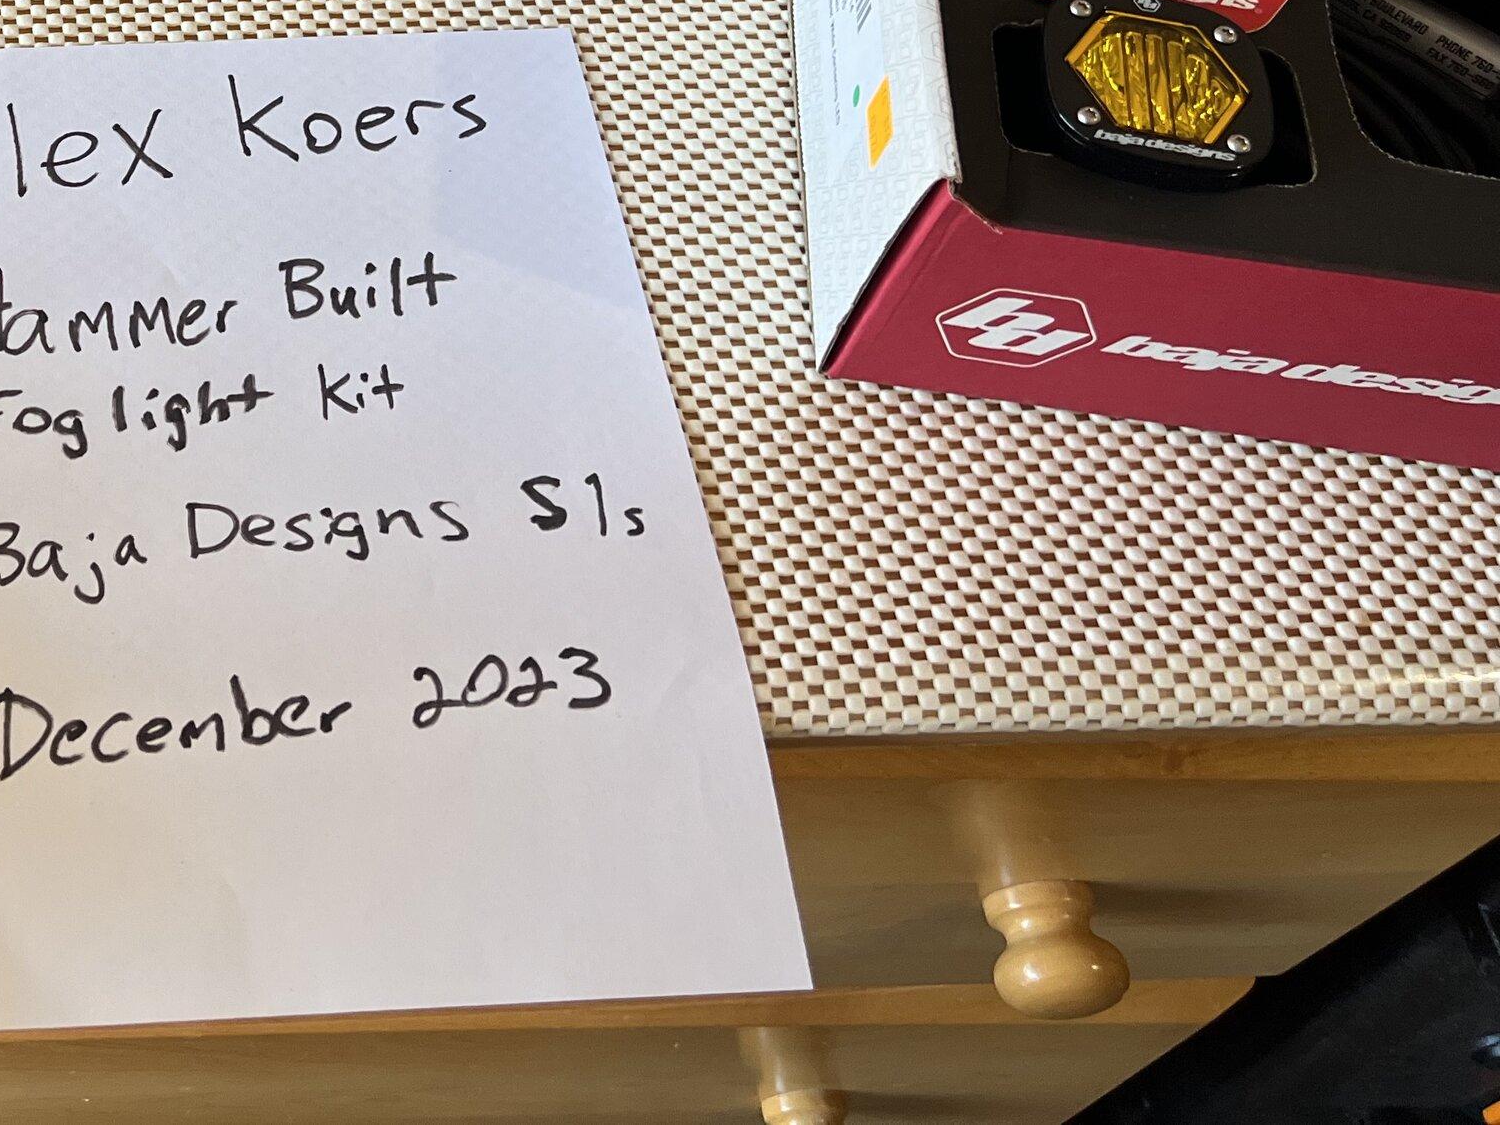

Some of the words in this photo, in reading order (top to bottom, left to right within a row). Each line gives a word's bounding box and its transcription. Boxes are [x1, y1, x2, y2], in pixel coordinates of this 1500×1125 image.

[228, 75, 486, 162] Koers
[1093, 129, 1145, 146] baja
[1144, 138, 1237, 162] designs
[279, 252, 457, 319] Built
[1099, 335, 1289, 376] baja
[186, 501, 469, 560] Designs
[413, 647, 611, 728] 2023
